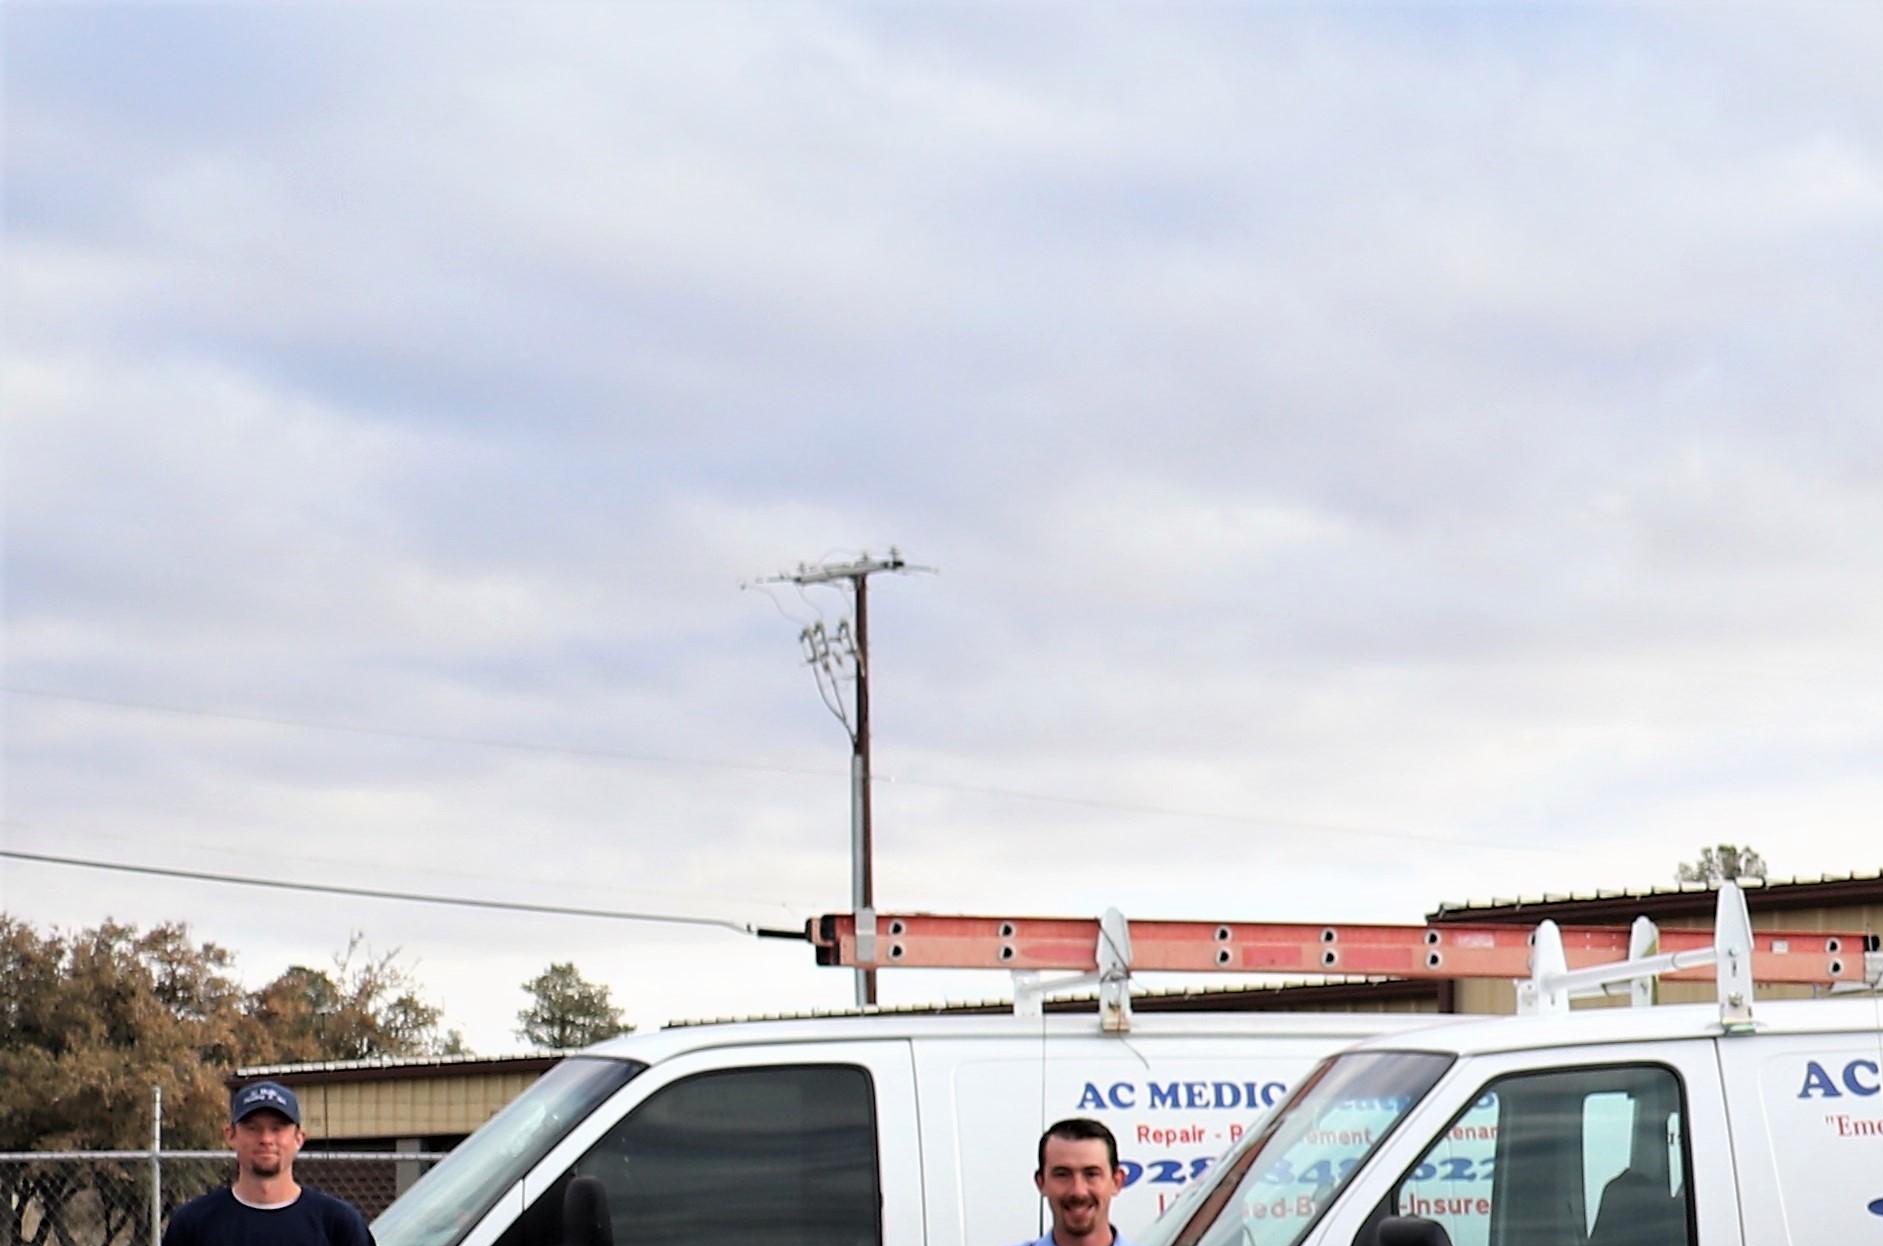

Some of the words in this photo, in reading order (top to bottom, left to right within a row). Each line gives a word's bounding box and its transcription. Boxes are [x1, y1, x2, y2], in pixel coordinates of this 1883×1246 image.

[1798, 1060, 1881, 1098] AC
[1076, 1082, 1136, 1109] AC
[1147, 1082, 1287, 1110] MEDIC
[1137, 1124, 1206, 1147] Repair
